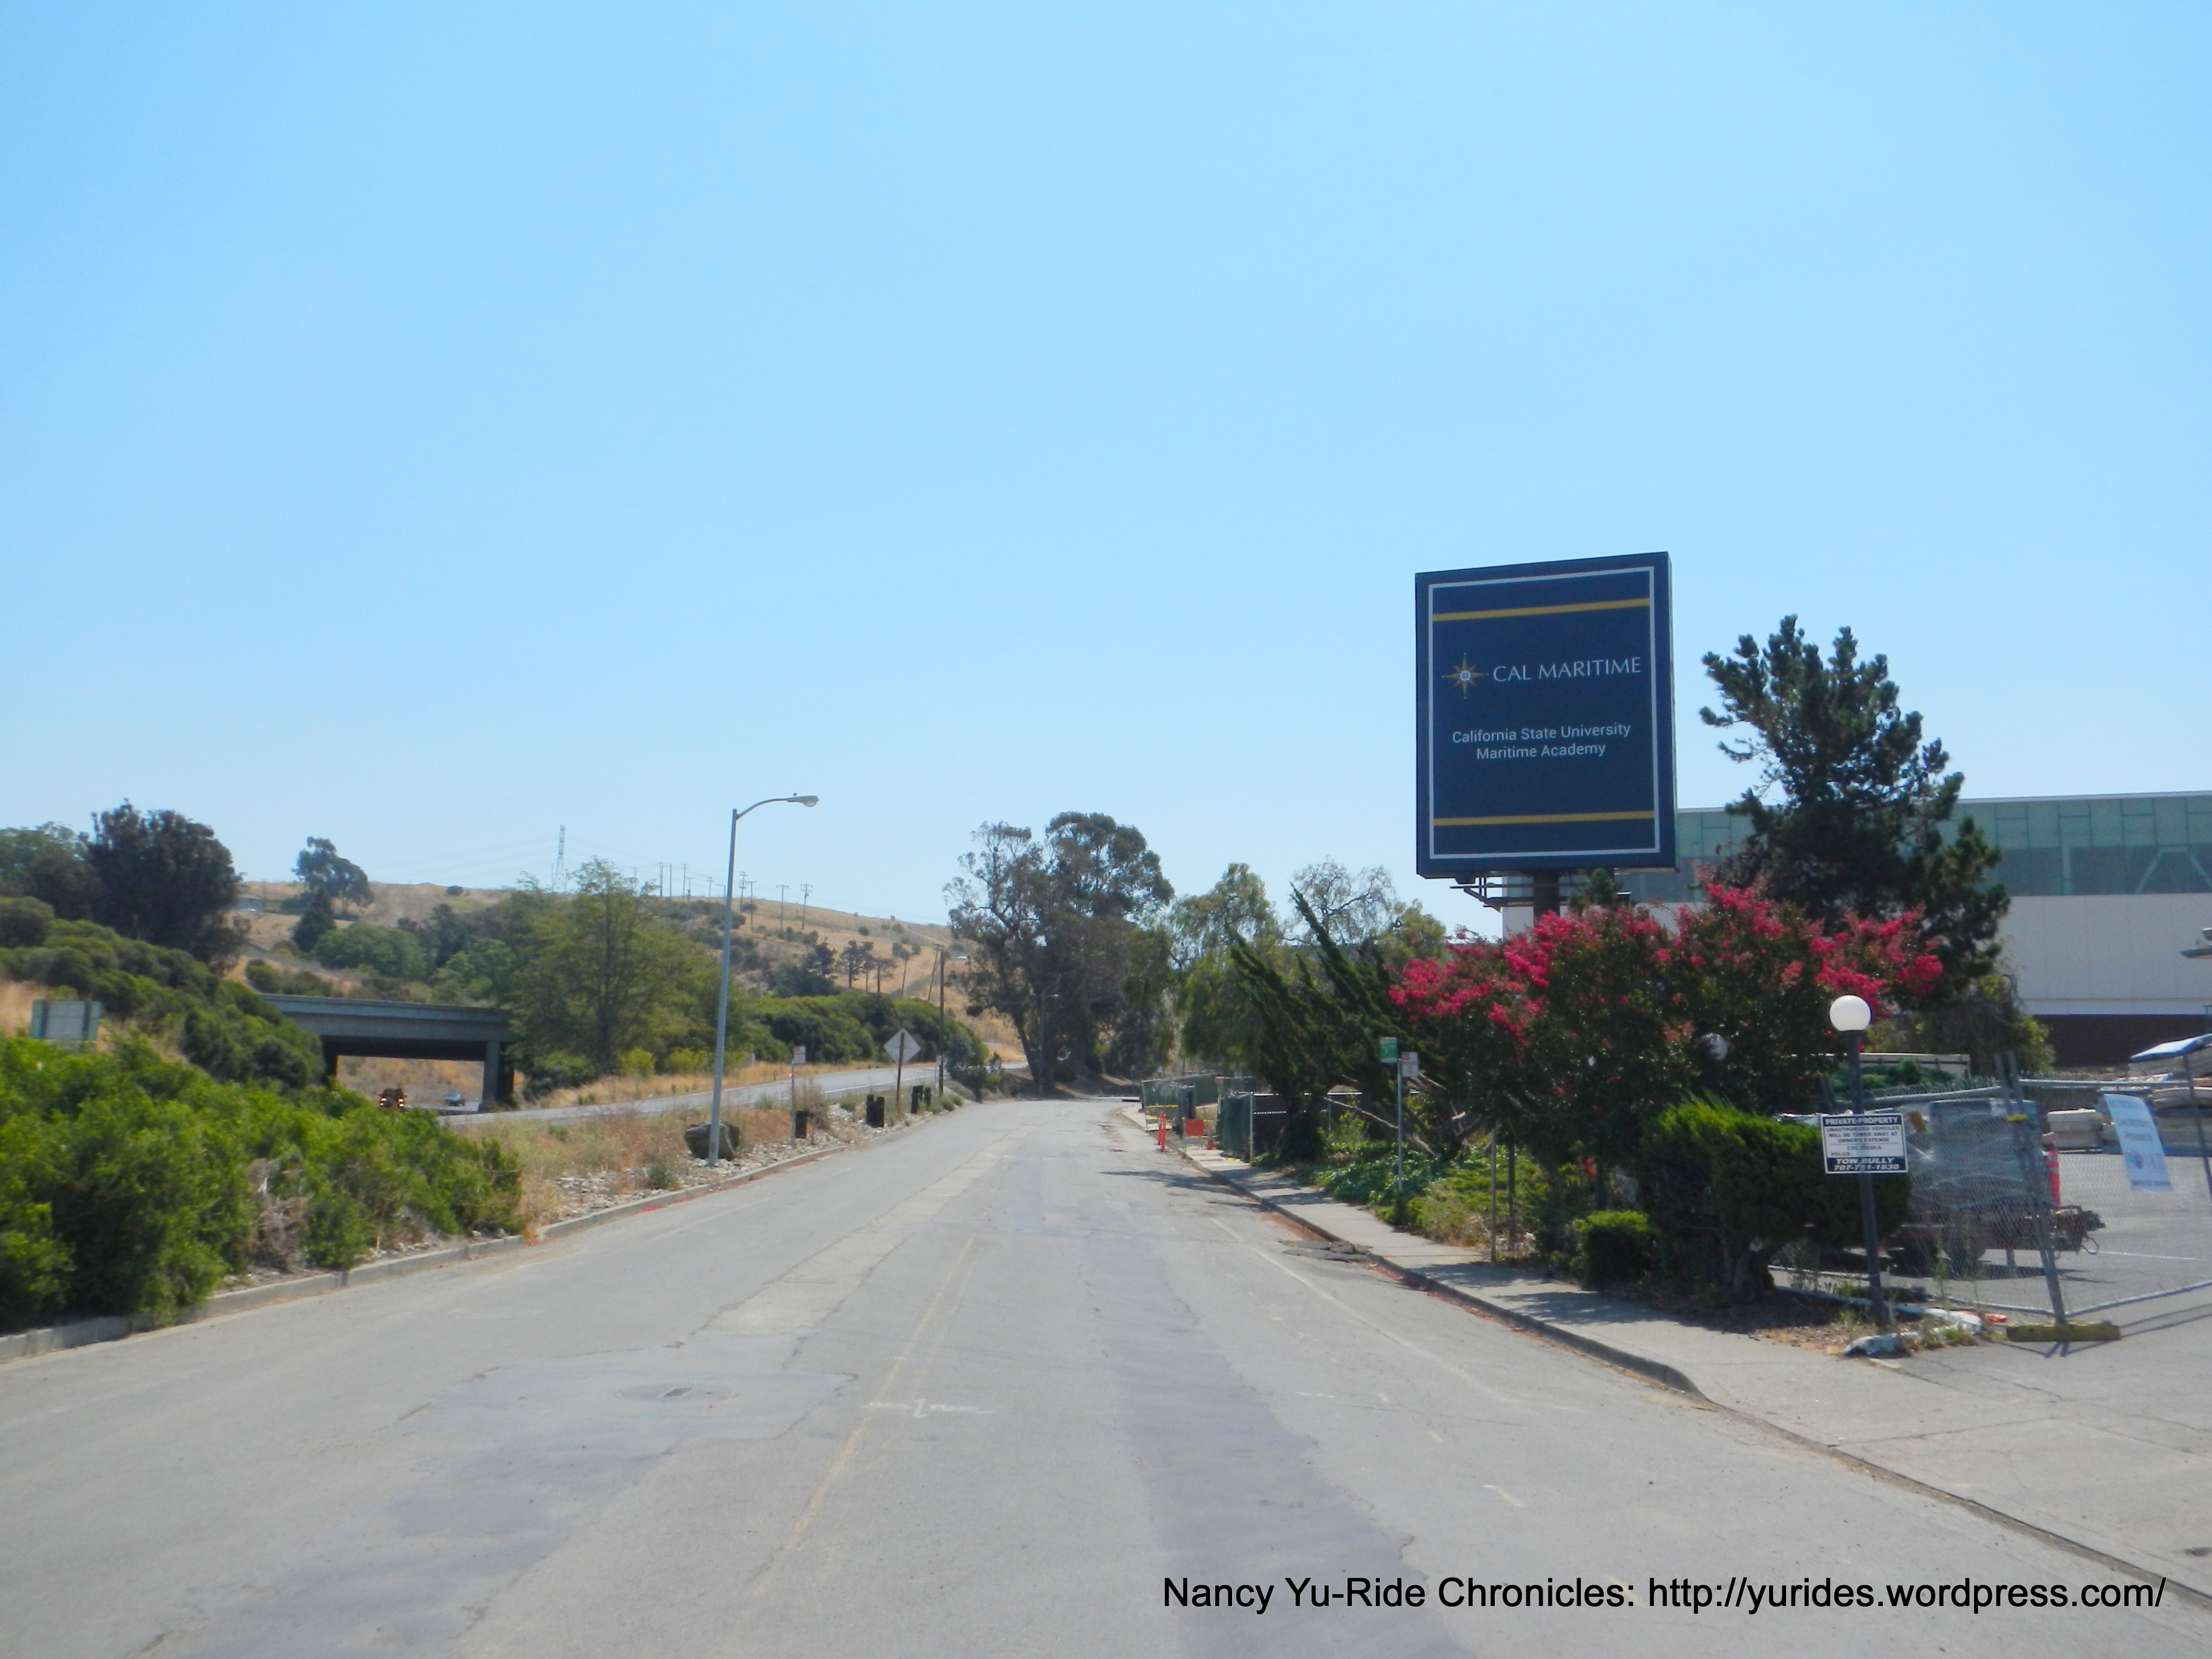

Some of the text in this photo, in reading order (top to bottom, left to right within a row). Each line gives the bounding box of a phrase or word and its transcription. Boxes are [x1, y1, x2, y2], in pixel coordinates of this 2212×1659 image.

[1493, 657, 1641, 682] CAL MARITIME
[1452, 723, 1631, 744] California State University
[1477, 742, 1606, 759] Maritime Academy
